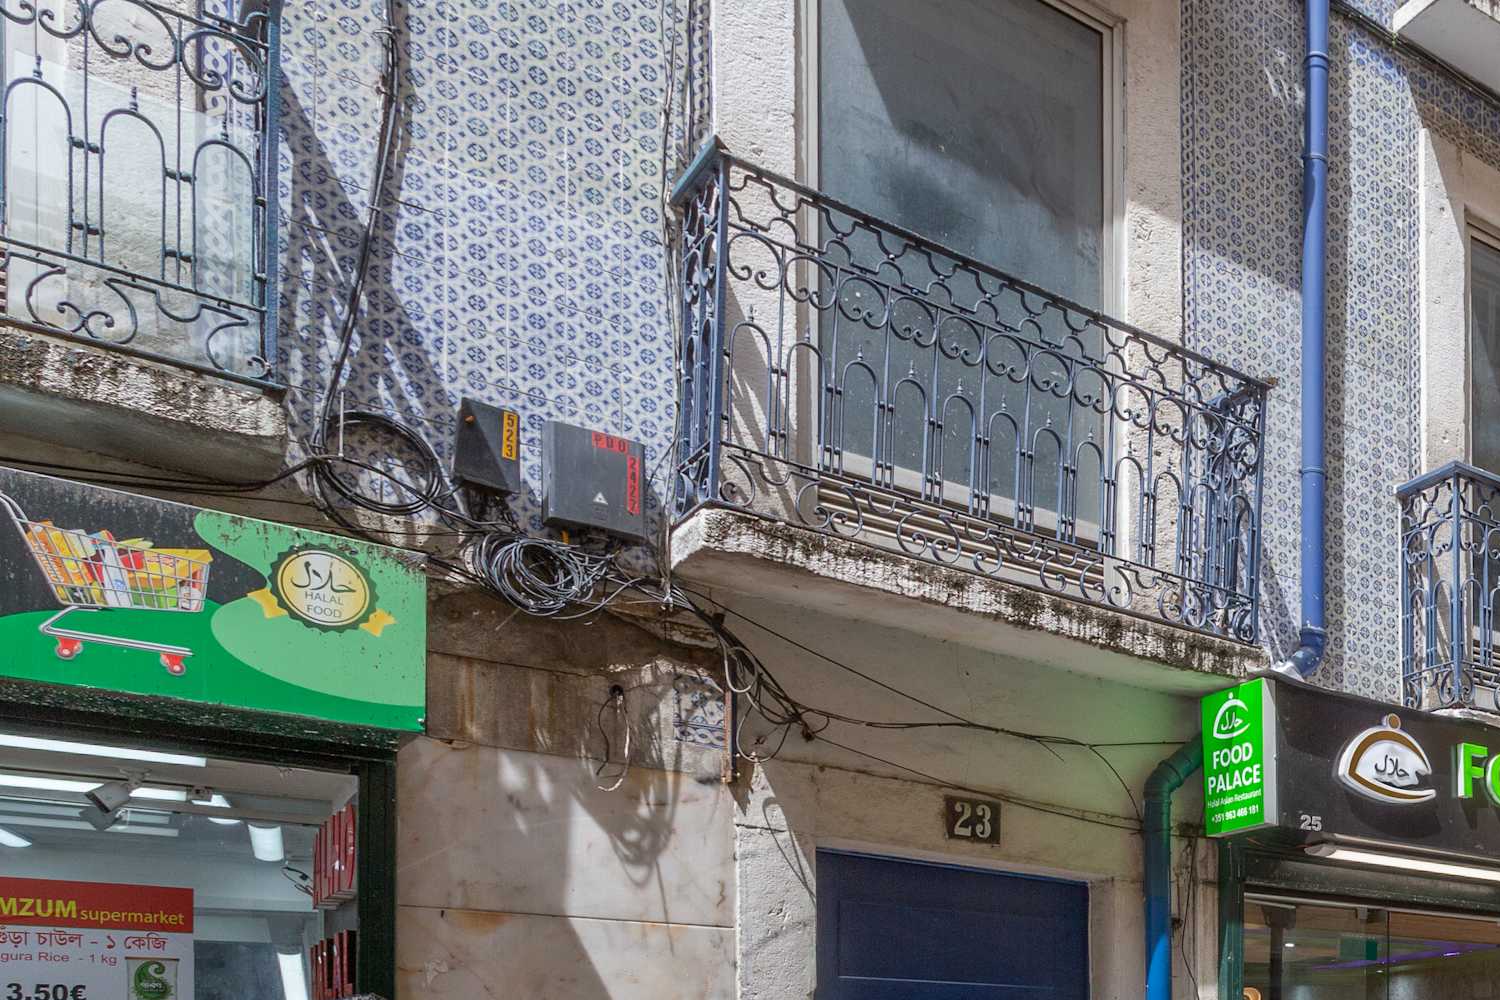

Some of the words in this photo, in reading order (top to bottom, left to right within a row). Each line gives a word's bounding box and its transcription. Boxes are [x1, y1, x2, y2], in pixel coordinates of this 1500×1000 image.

[291, 561, 357, 593] حلال
[305, 591, 344, 606] HALAL
[306, 604, 342, 618] FOOD
[1213, 742, 1253, 769] FOOD
[1374, 754, 1409, 777] حلال
[1208, 764, 1261, 795] PALACE
[954, 802, 991, 838] 23
[1300, 815, 1322, 831] 25
[81, 909, 185, 925] supermarket
[38, 952, 70, 962] Rice
[101, 954, 117, 966] kg
